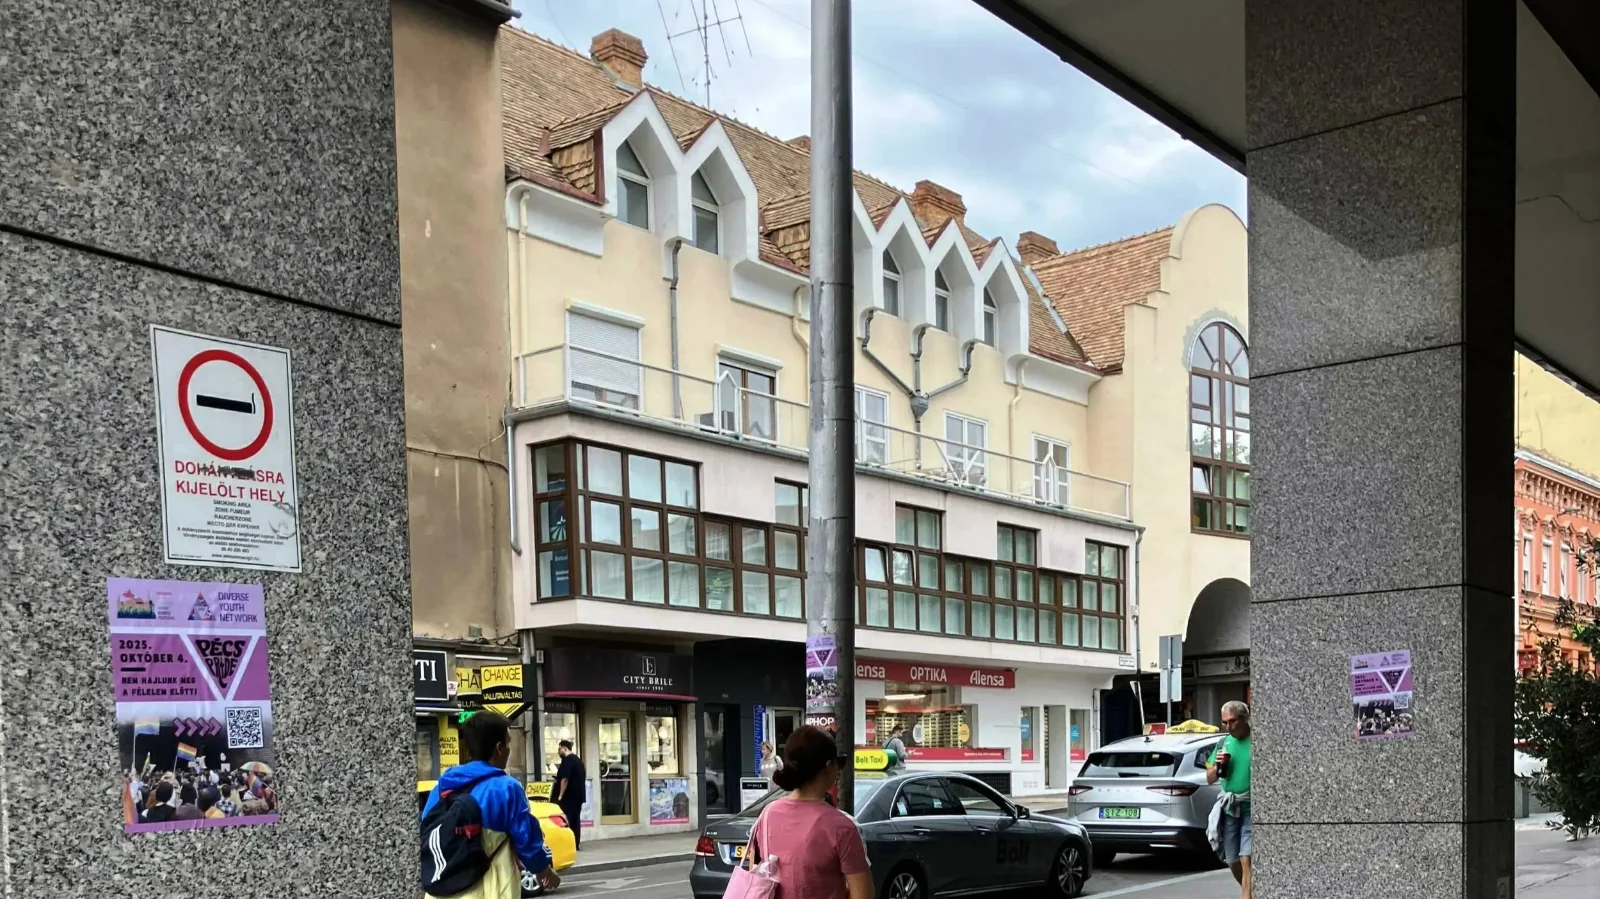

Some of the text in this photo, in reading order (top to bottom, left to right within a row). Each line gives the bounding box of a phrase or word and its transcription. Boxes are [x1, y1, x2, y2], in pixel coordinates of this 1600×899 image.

[176, 480, 285, 503] KIJELÖLT HELY
[213, 499, 236, 507] SMOKING
[229, 507, 250, 515] FUMEUR
[214, 513, 252, 522] RAUCHERZONE
[218, 592, 249, 601] DIVERSE
[219, 602, 245, 612] YOUTH
[119, 640, 152, 650] 2025.
[195, 638, 246, 658] PÉCS
[120, 652, 188, 663] OKTÓBER 4.
[205, 658, 239, 689] PRIDE
[483, 667, 521, 682] CHANGE
[910, 666, 947, 682] OPTIKA
[969, 670, 1005, 687] Alensa
[623, 675, 673, 686] CITY BRILL
[132, 687, 167, 696] FÉLELEM
[869, 754, 883, 763] Taxi
[526, 784, 551, 795] CHANGE
